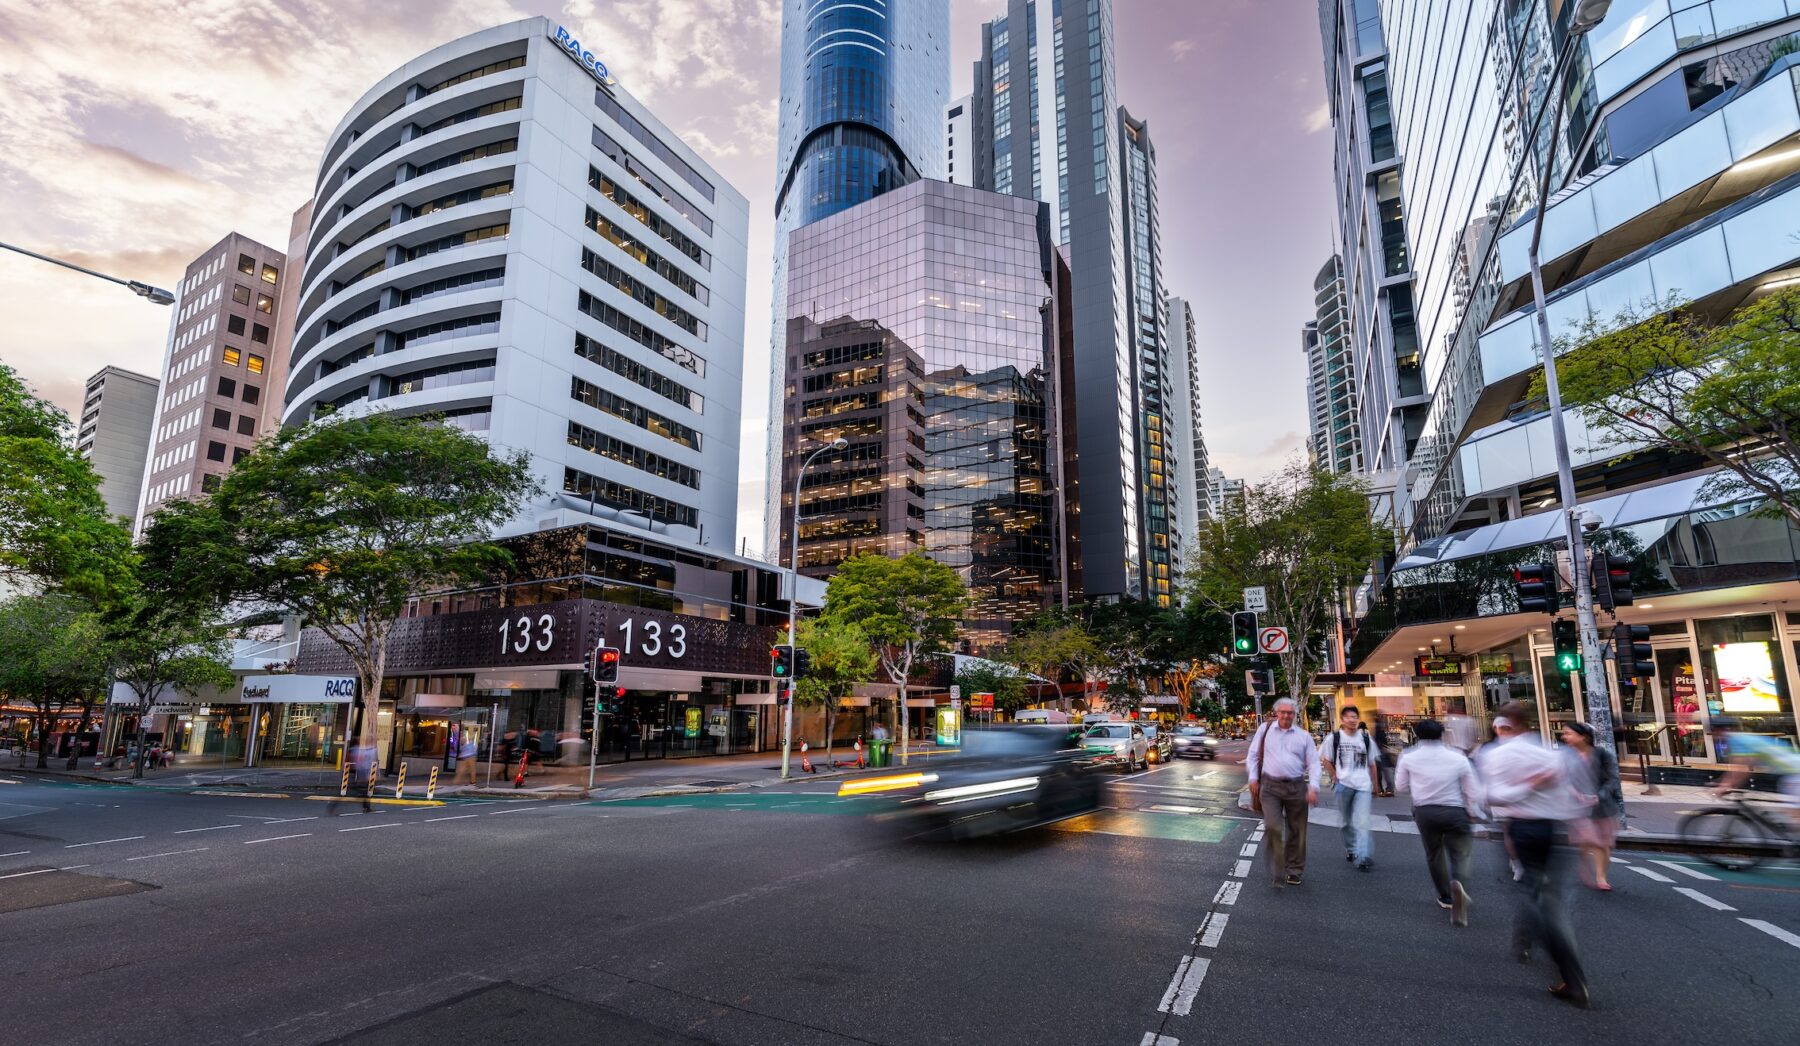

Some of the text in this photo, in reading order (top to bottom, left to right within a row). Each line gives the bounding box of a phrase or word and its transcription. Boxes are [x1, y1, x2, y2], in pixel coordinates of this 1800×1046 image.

[556, 25, 609, 78] RACQ
[499, 614, 555, 655] 133
[619, 618, 687, 659] 133
[325, 679, 354, 697] RACQ
